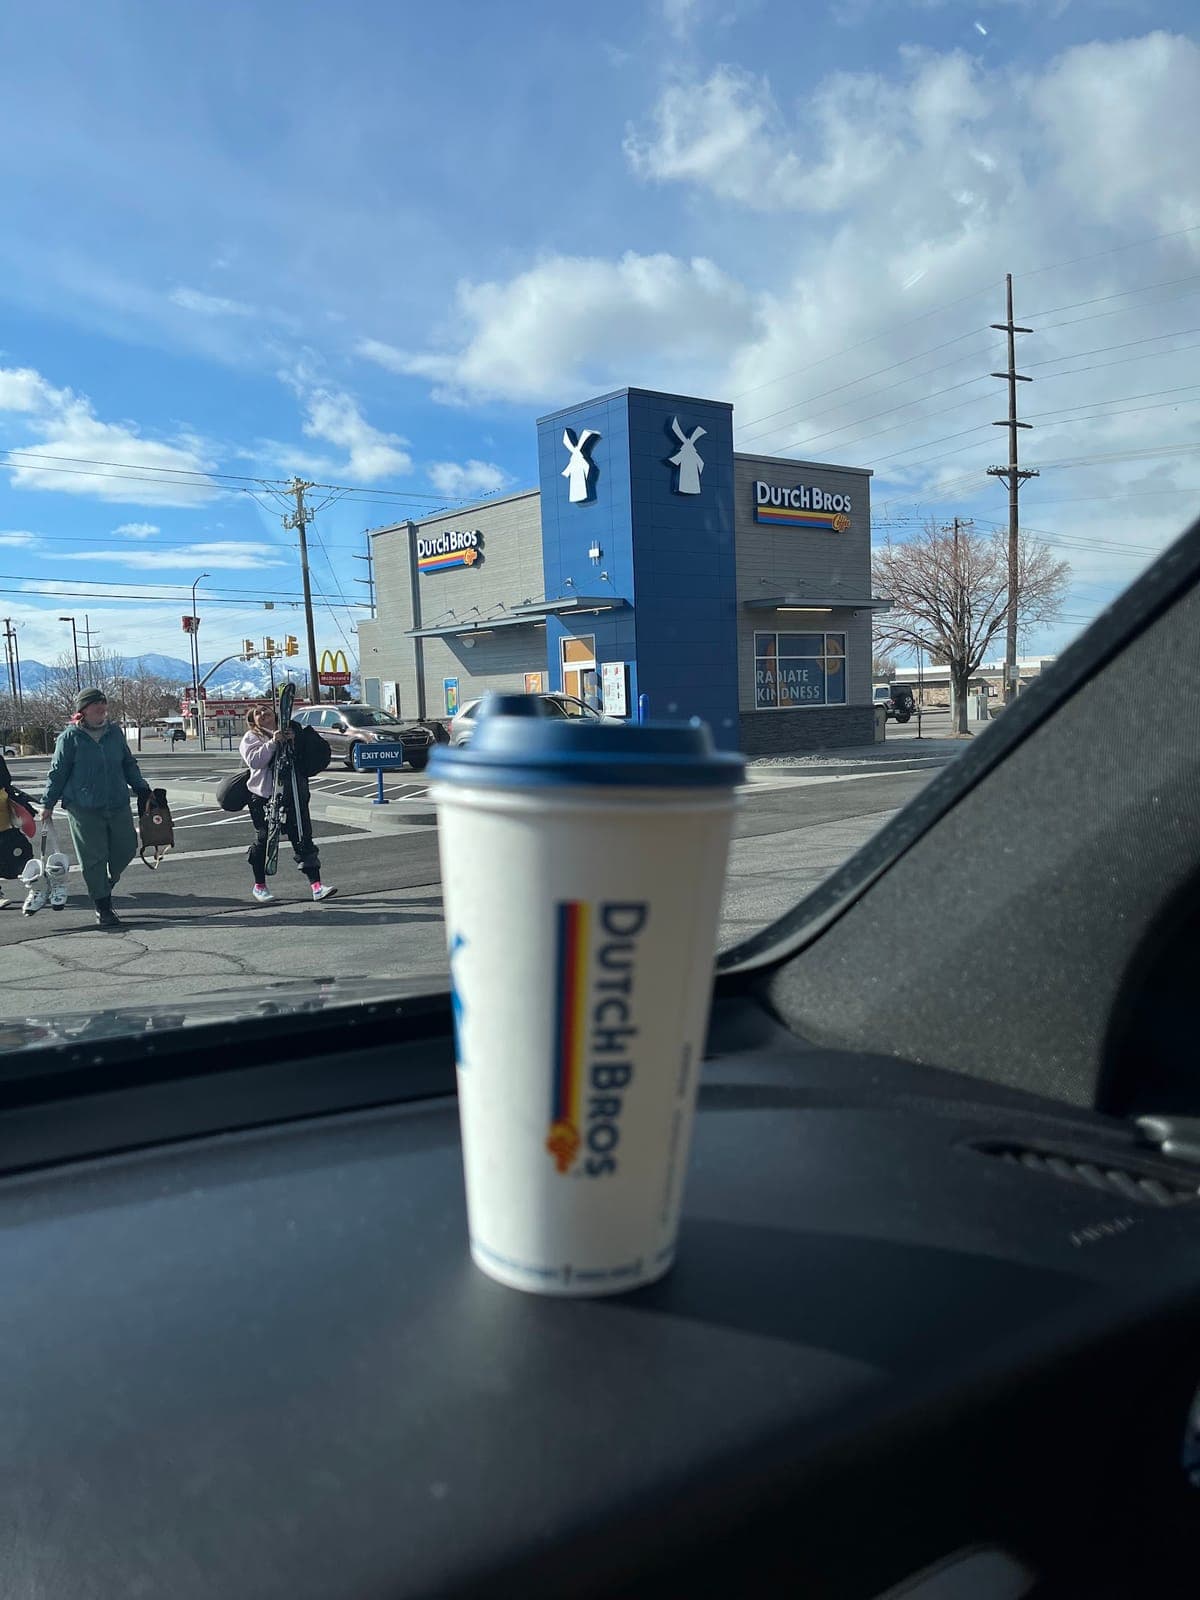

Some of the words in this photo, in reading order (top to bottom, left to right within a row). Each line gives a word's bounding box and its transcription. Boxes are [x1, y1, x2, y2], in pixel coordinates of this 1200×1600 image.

[757, 481, 810, 508] DUTCH
[812, 487, 852, 512] BROS
[417, 532, 449, 557] DUTCH
[450, 531, 477, 550] BROS
[756, 669, 809, 684] RADIATE
[757, 685, 820, 701] KINDNESS
[592, 901, 647, 1054] DUTCH
[585, 1062, 632, 1178] BROS
